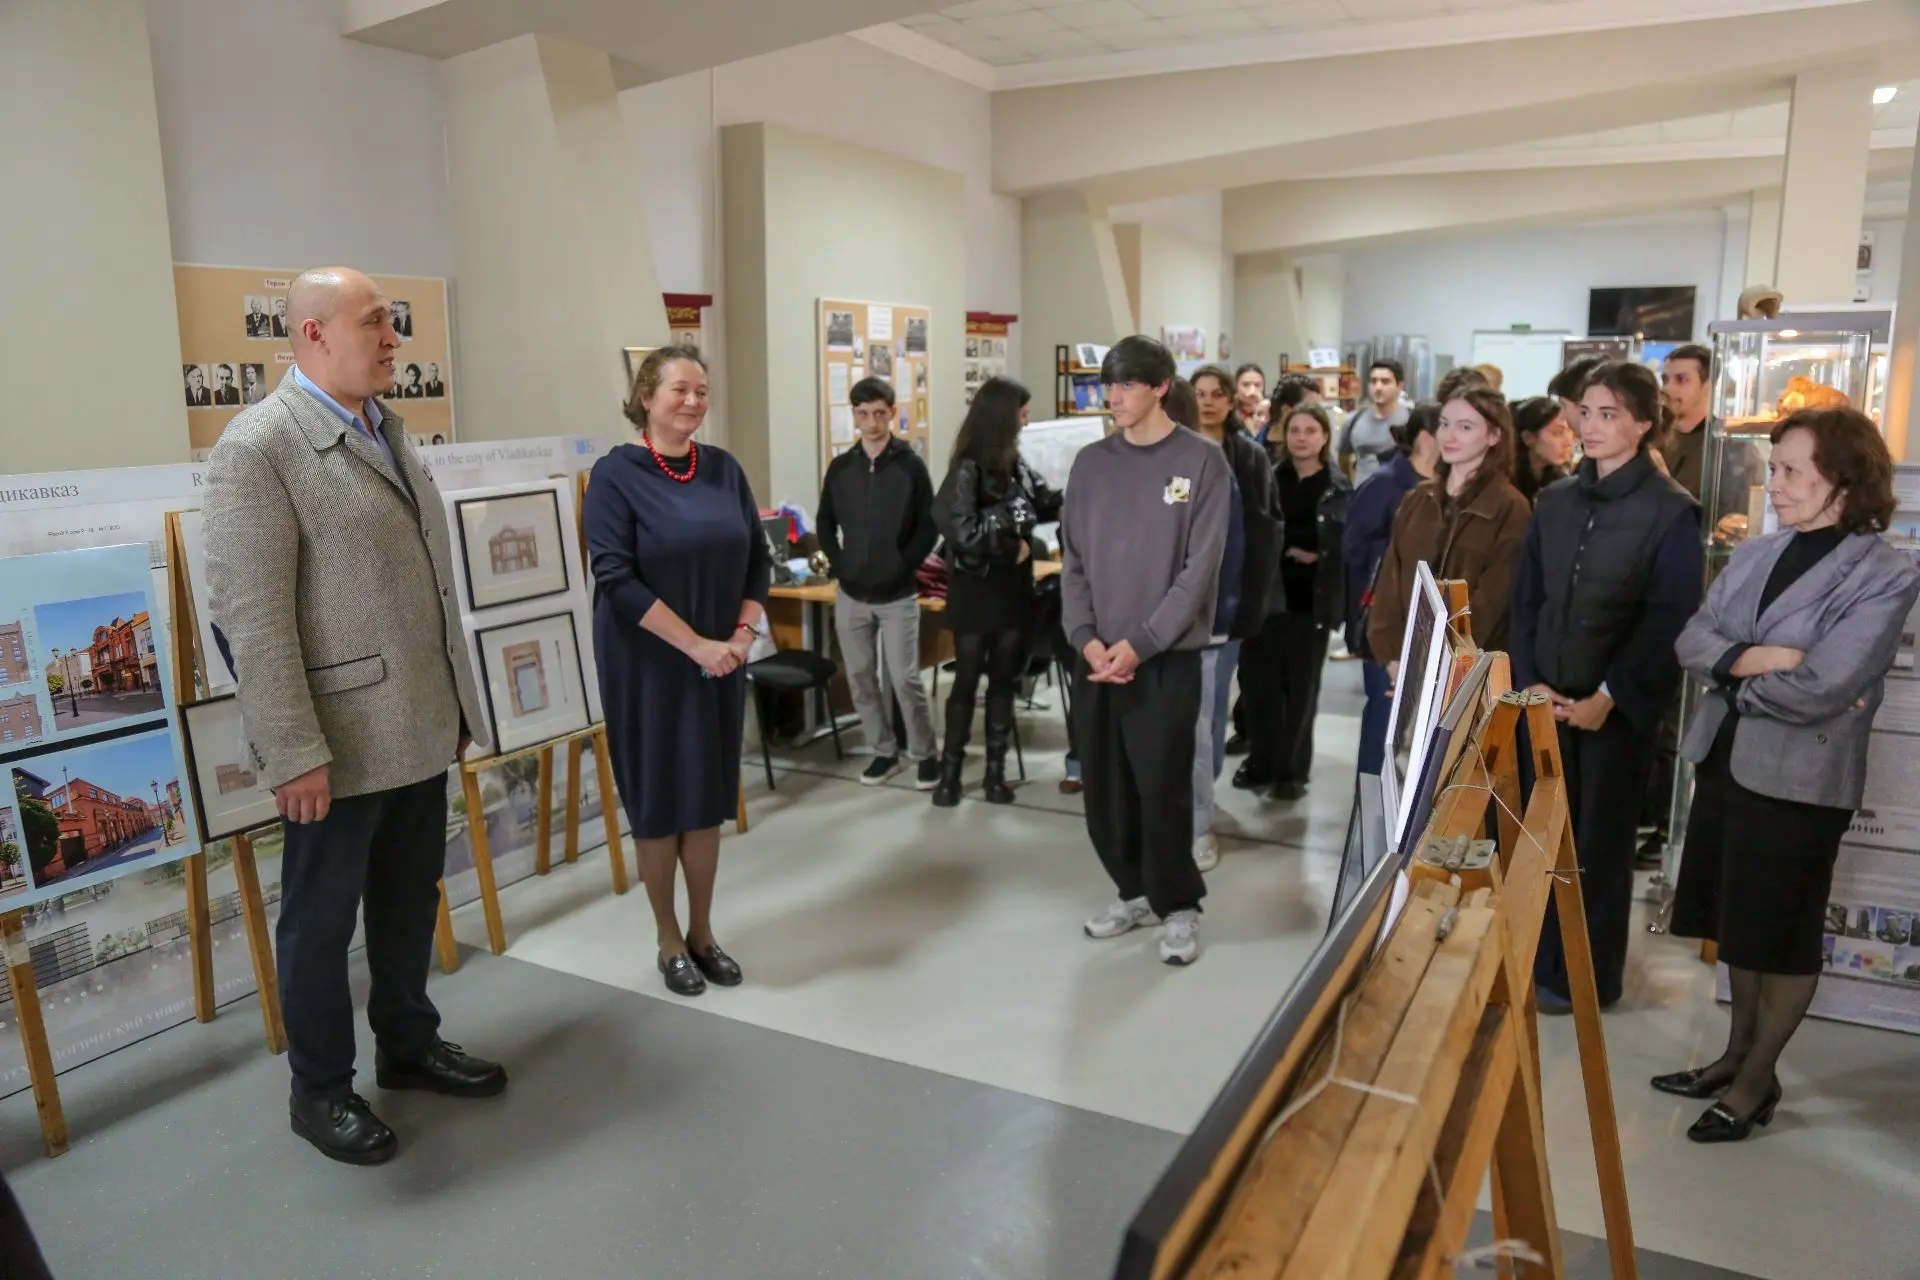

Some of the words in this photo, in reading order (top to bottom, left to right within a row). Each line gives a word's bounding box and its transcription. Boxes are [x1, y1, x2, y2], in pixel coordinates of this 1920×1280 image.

[448, 452, 463, 466] the
[466, 452, 482, 467] city
[498, 446, 553, 460] Vladikavkaz
